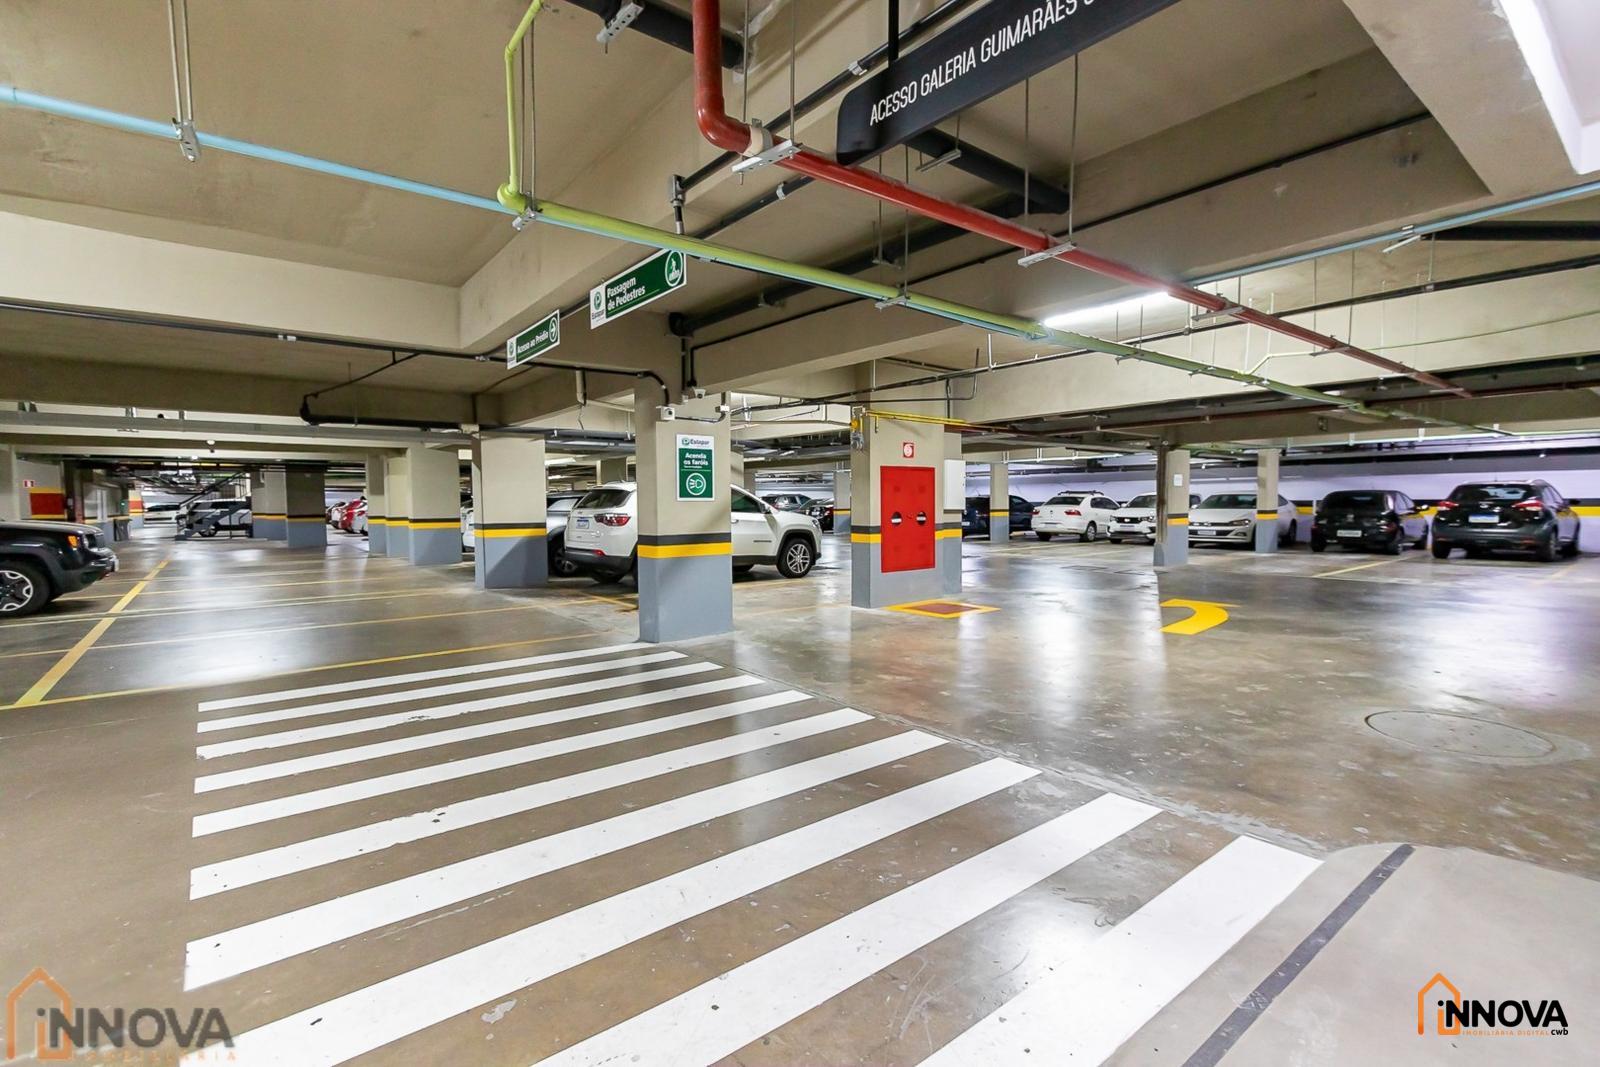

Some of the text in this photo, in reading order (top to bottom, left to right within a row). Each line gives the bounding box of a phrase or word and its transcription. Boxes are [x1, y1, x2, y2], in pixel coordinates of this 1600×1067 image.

[870, 0, 1078, 126] ACESSO GALERIA GUIMARÃES
[607, 277, 636, 298] Passagem
[607, 286, 646, 311] de Pedestres
